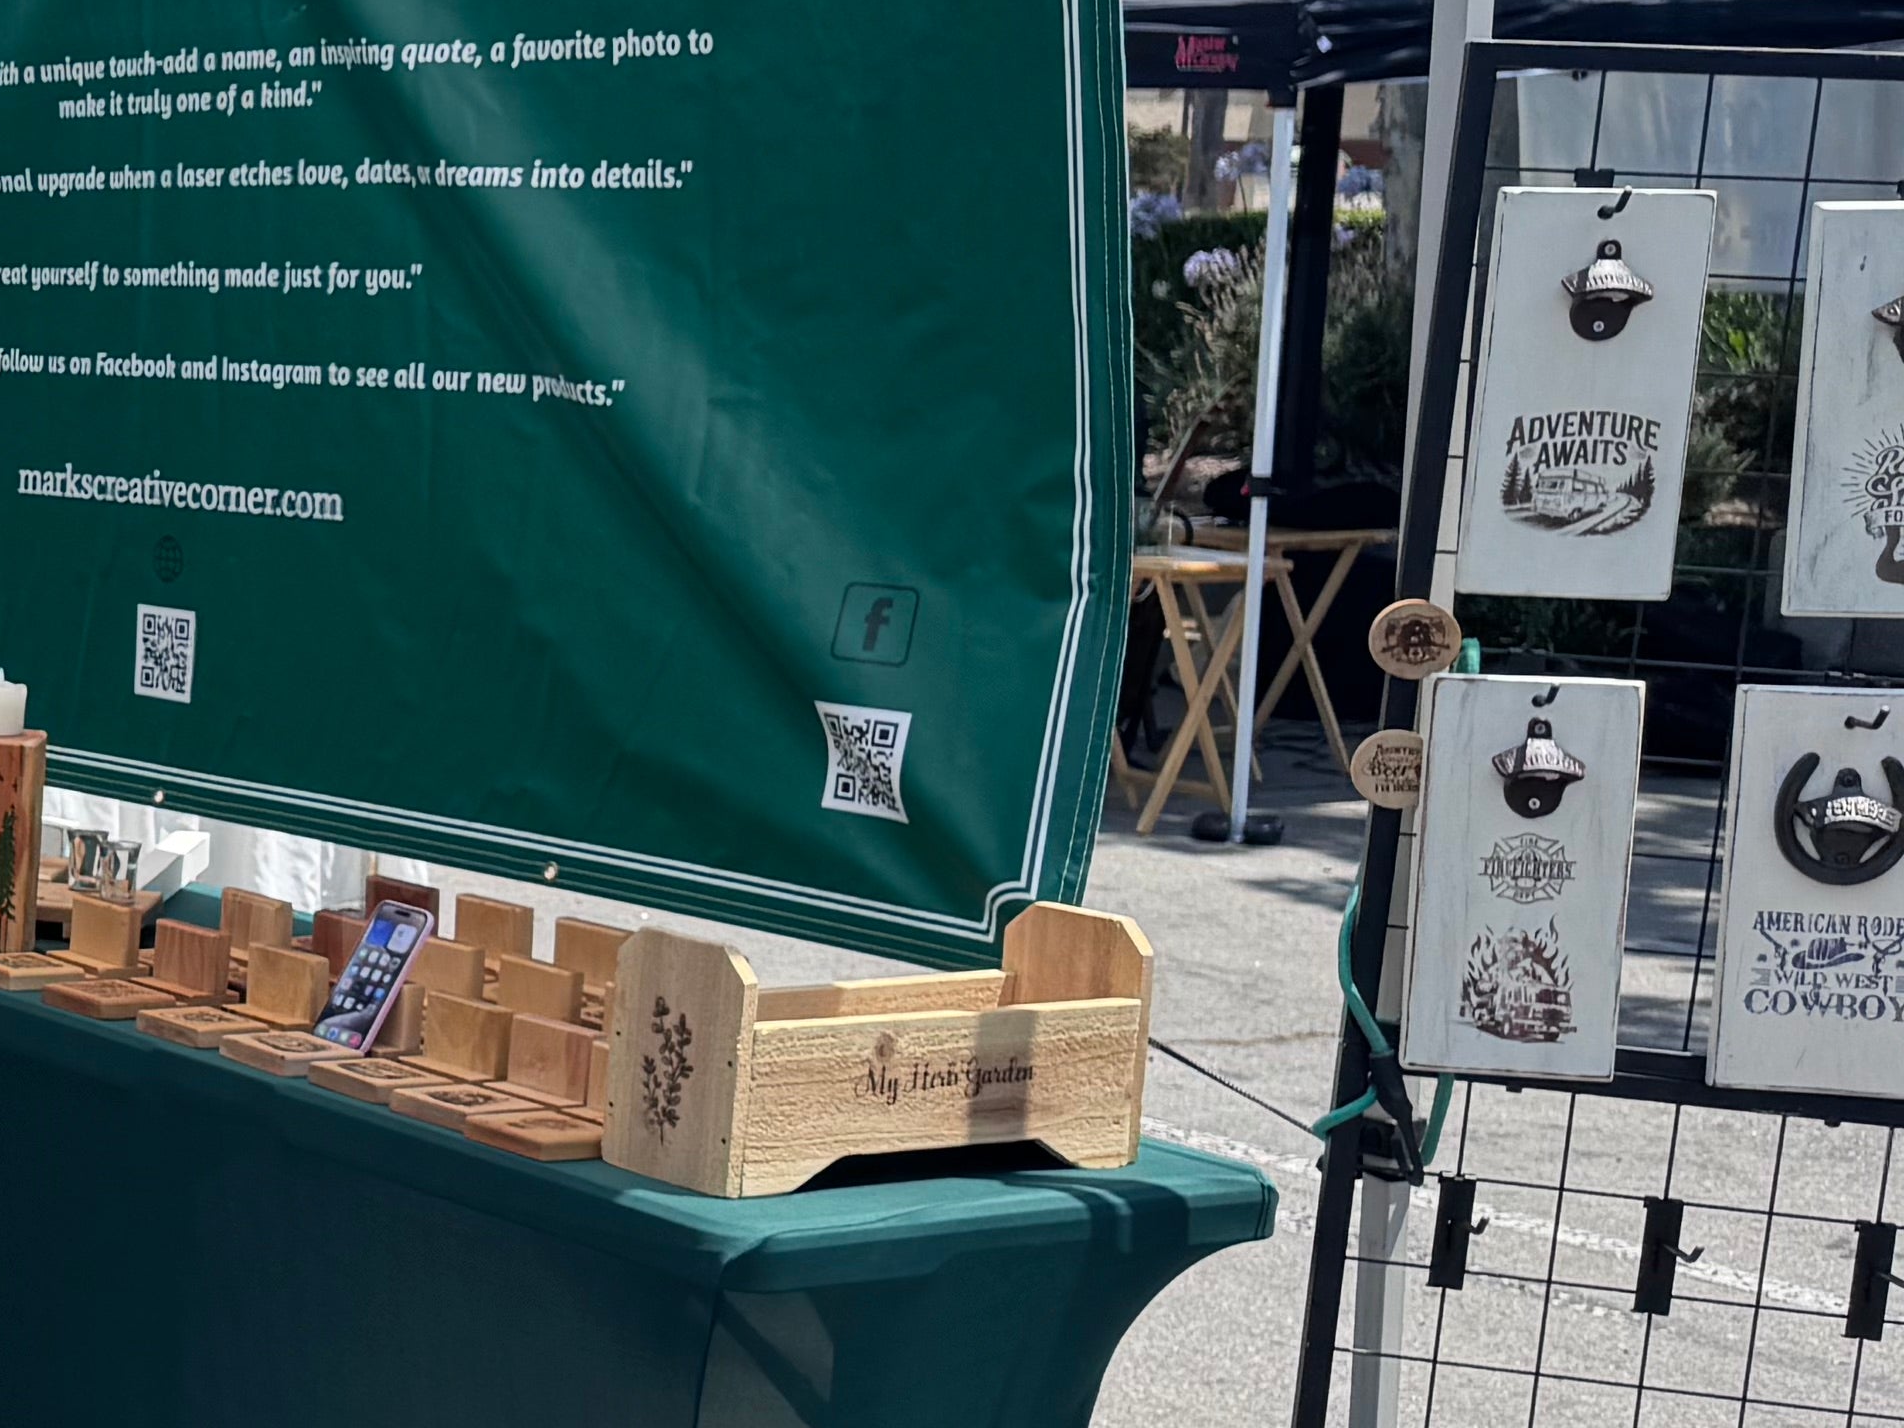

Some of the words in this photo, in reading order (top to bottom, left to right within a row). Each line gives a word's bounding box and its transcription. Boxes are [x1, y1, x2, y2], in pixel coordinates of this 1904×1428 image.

[37, 165, 106, 198] upgrade
[109, 163, 156, 190] when
[160, 169, 172, 189] a
[176, 162, 226, 189] laser
[228, 159, 293, 187] etches
[297, 158, 349, 190] love,
[354, 156, 417, 189] dates,
[434, 159, 525, 188] dreams
[530, 158, 585, 189] into
[31, 260, 100, 292] yourself
[102, 263, 120, 286] to
[123, 260, 220, 294] something
[224, 261, 280, 288] made
[282, 260, 323, 295] just
[326, 261, 361, 295] for
[48, 355, 66, 374] us
[69, 356, 92, 376] on
[95, 351, 177, 379] Facebook
[180, 354, 218, 381] and
[221, 356, 322, 390] Instagram
[327, 362, 351, 387] to
[355, 366, 390, 388] see
[393, 361, 426, 390] all
[431, 370, 472, 392] our
[477, 372, 527, 394] new
[1505, 410, 1661, 455] ADVENTURE
[1533, 439, 1628, 471] AWAITS
[17, 462, 344, 522] markscreativecorner.com
[1752, 910, 1852, 935] AMERICAN
[1774, 969, 1828, 992] WILD
[1835, 973, 1894, 996] WEST
[855, 1058, 899, 1105] My
[964, 1056, 1035, 1098] Garden
